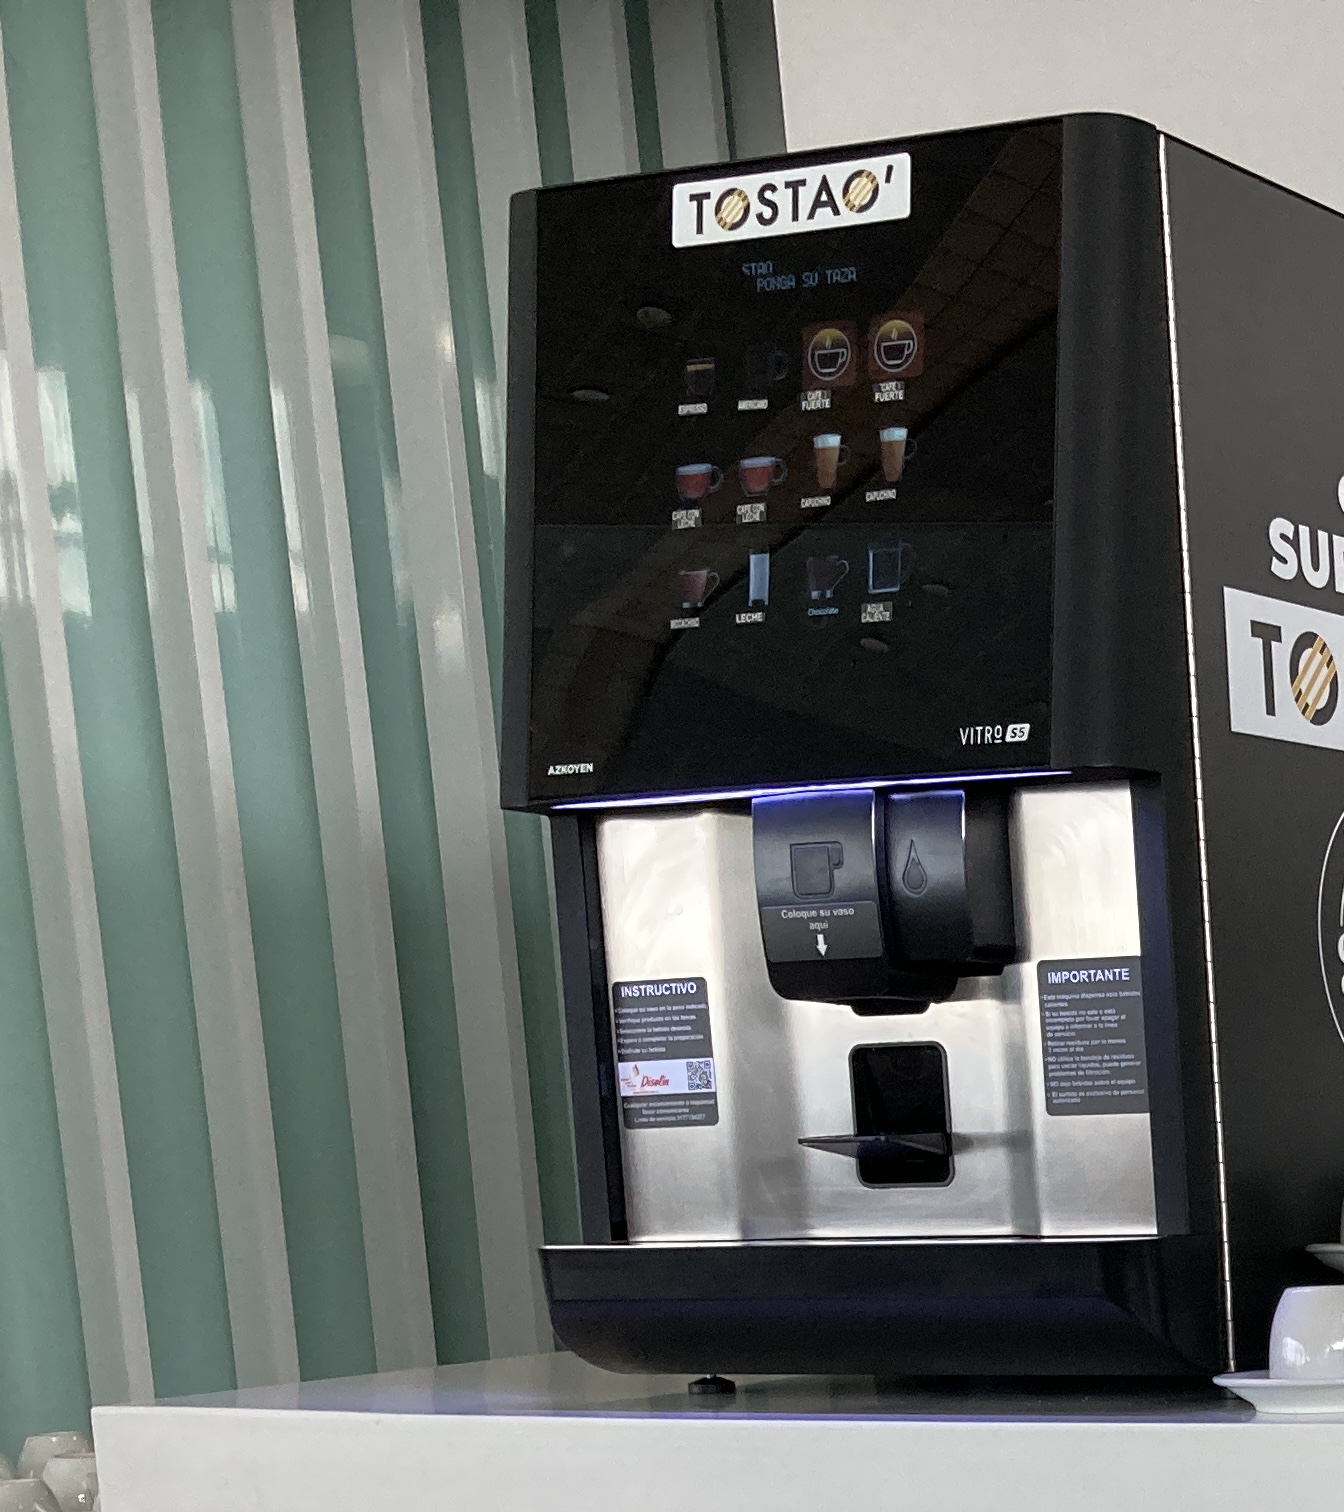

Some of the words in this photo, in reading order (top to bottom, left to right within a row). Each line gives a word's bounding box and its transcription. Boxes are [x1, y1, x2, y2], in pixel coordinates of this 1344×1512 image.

[802, 271, 819, 287] SU
[826, 267, 857, 285] TAZA
[875, 390, 904, 402] FUERTE
[736, 612, 764, 624] LECHE
[1009, 725, 1027, 741] S5
[547, 761, 594, 776] AZKOYEN
[781, 909, 817, 920] Coloque
[820, 909, 831, 917] su
[833, 908, 855, 916] vaso
[1047, 968, 1130, 984] IMPORTANTE
[621, 982, 697, 998] INSTRUCTIVO
